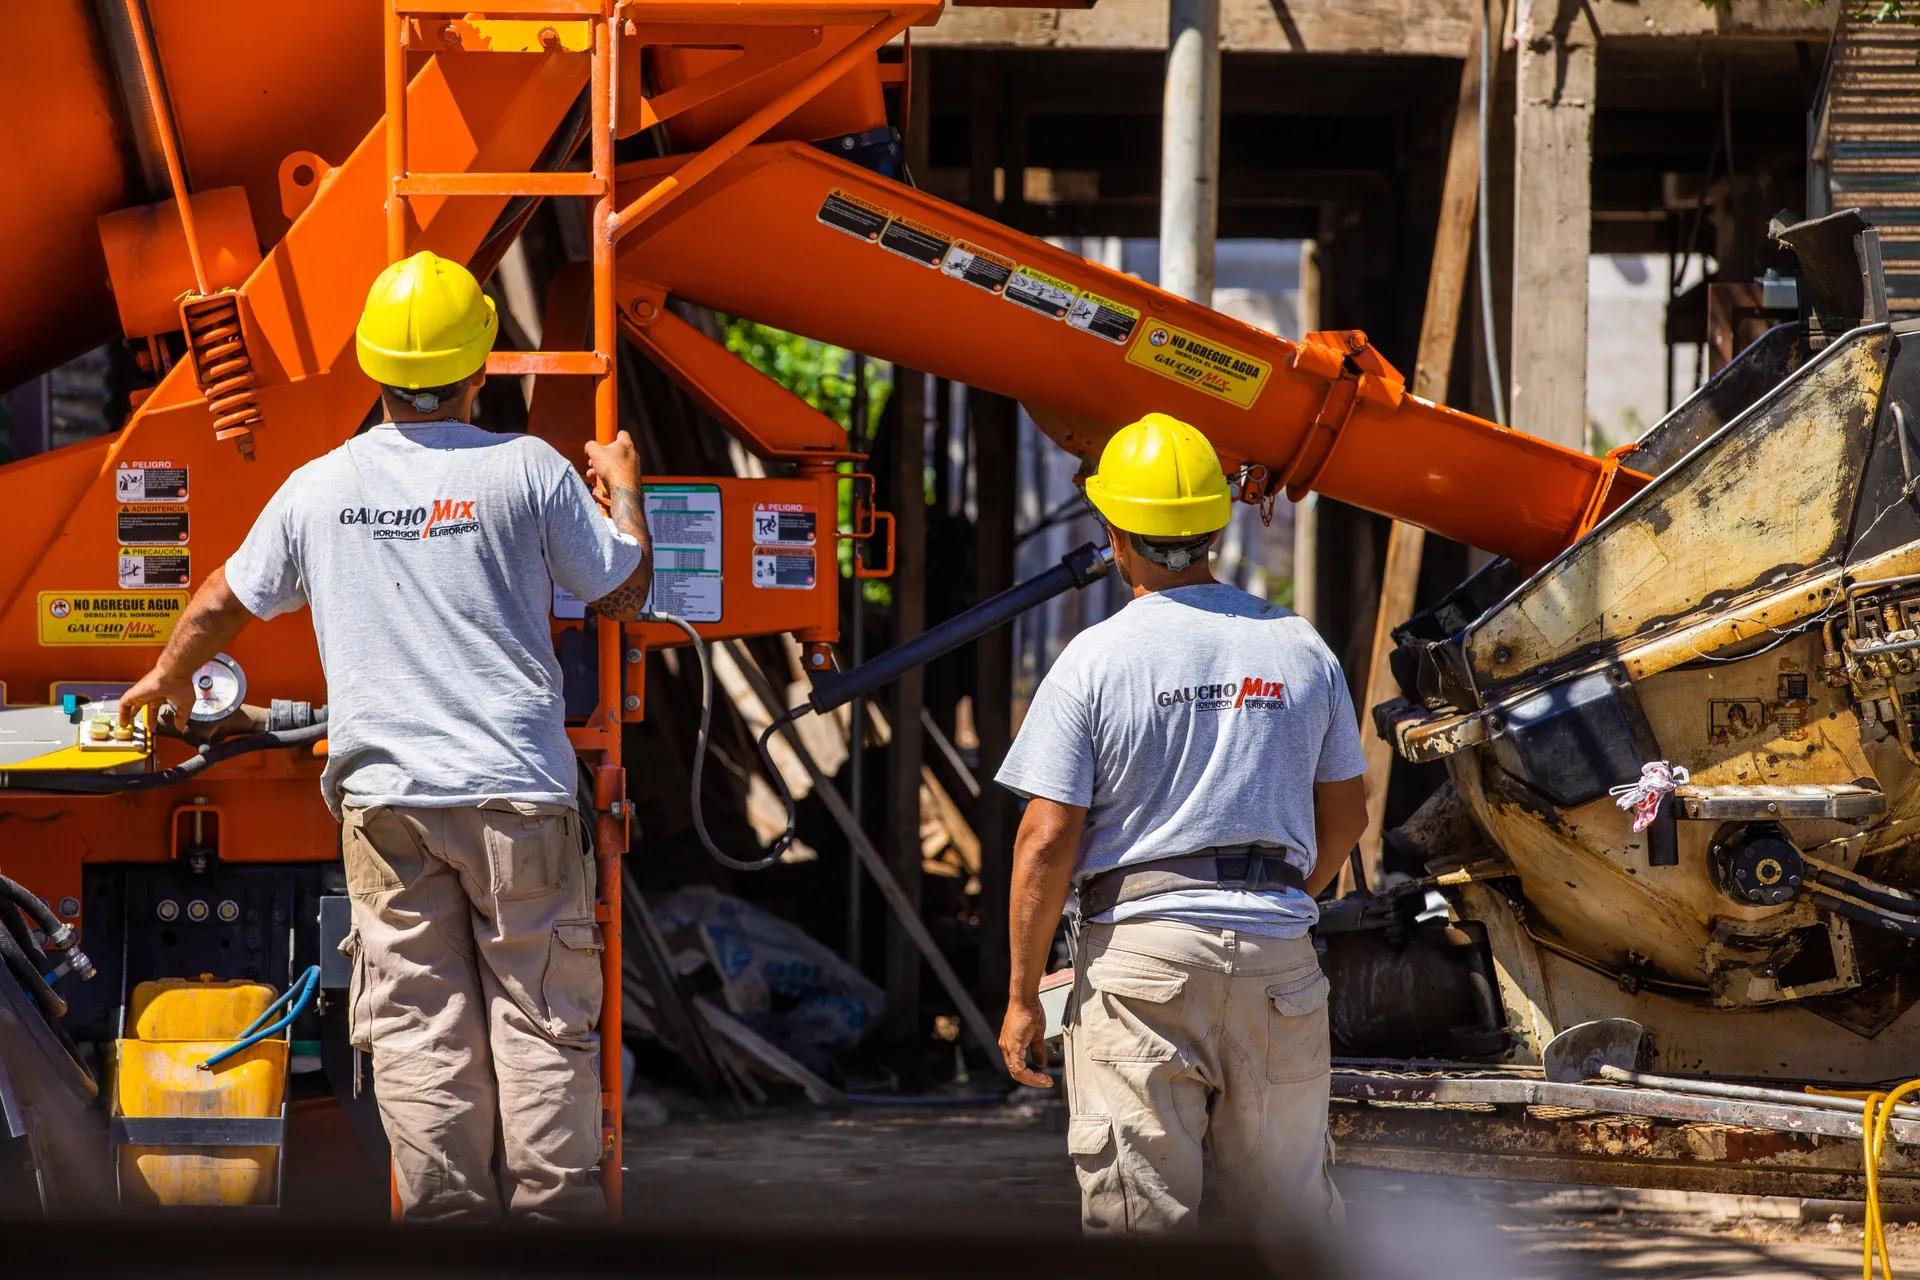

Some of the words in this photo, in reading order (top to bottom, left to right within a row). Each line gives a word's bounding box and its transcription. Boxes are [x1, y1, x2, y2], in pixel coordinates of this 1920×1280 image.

[843, 190, 888, 216] ADVERTENCIA
[905, 218, 951, 242] ADVERTENCIA
[966, 245, 1013, 268] ADVERTENCIA
[1029, 270, 1073, 293] PRECAUCIÓN
[1091, 295, 1135, 317] PRECAUCIÓN
[1154, 354, 1203, 378] GAUCHO
[1170, 334, 1186, 349] NO
[1186, 341, 1232, 368] AGREGUE
[1231, 359, 1260, 379] AGUA
[132, 461, 172, 469] PELIGRO
[132, 504, 185, 513] ADVERTENCIA
[340, 507, 427, 526] GAUCHO
[768, 503, 803, 512] PELIGRO
[373, 526, 420, 539] HORMIGÓN
[430, 524, 479, 538] ELABORADO
[132, 546, 183, 555] PRECAUCIÓN
[74, 599, 90, 611] NO
[93, 599, 145, 611] AGREGUE
[148, 599, 179, 611] AGUA
[67, 623, 123, 633] GAUCHO
[1157, 683, 1237, 707] GAUCHO
